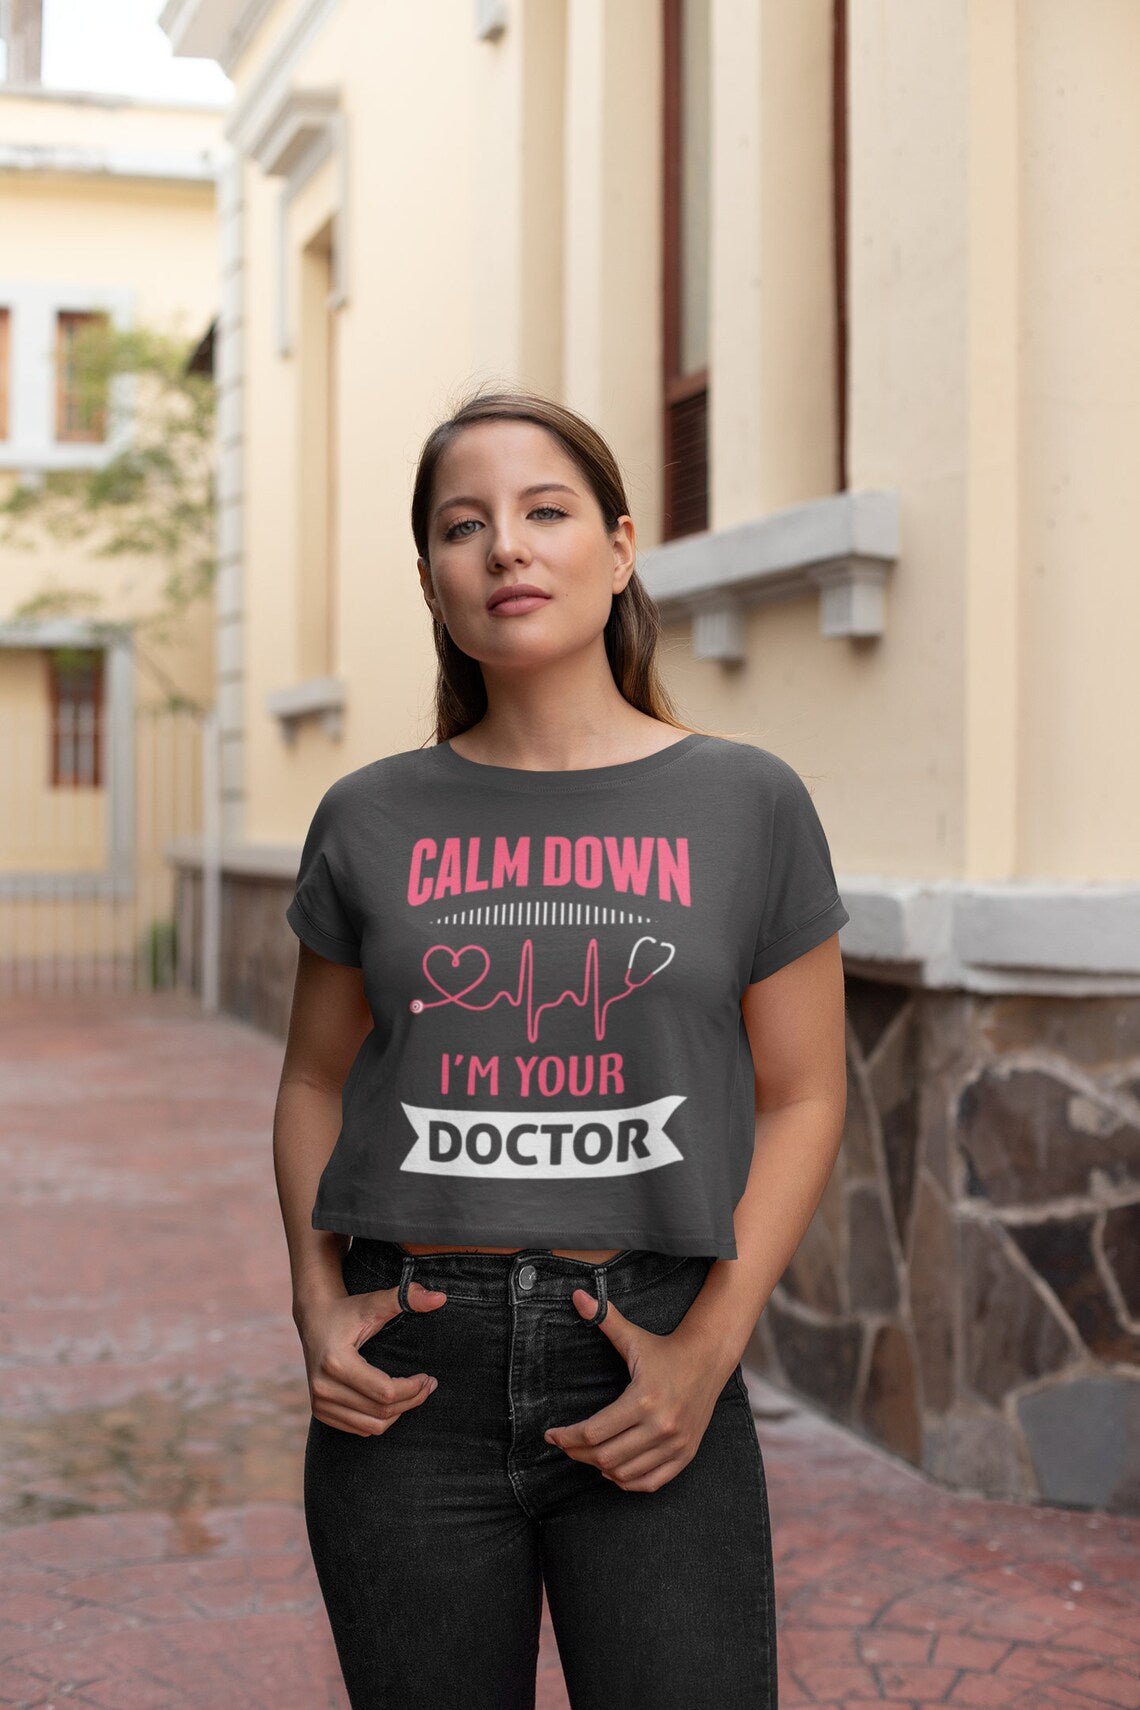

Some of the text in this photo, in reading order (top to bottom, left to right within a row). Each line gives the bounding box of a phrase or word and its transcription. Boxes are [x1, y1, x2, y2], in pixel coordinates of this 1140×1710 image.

[407, 836, 691, 908] CALM DOWN
[441, 1053, 625, 1097] I'M YOUR
[428, 1118, 652, 1166] DOCTOR
